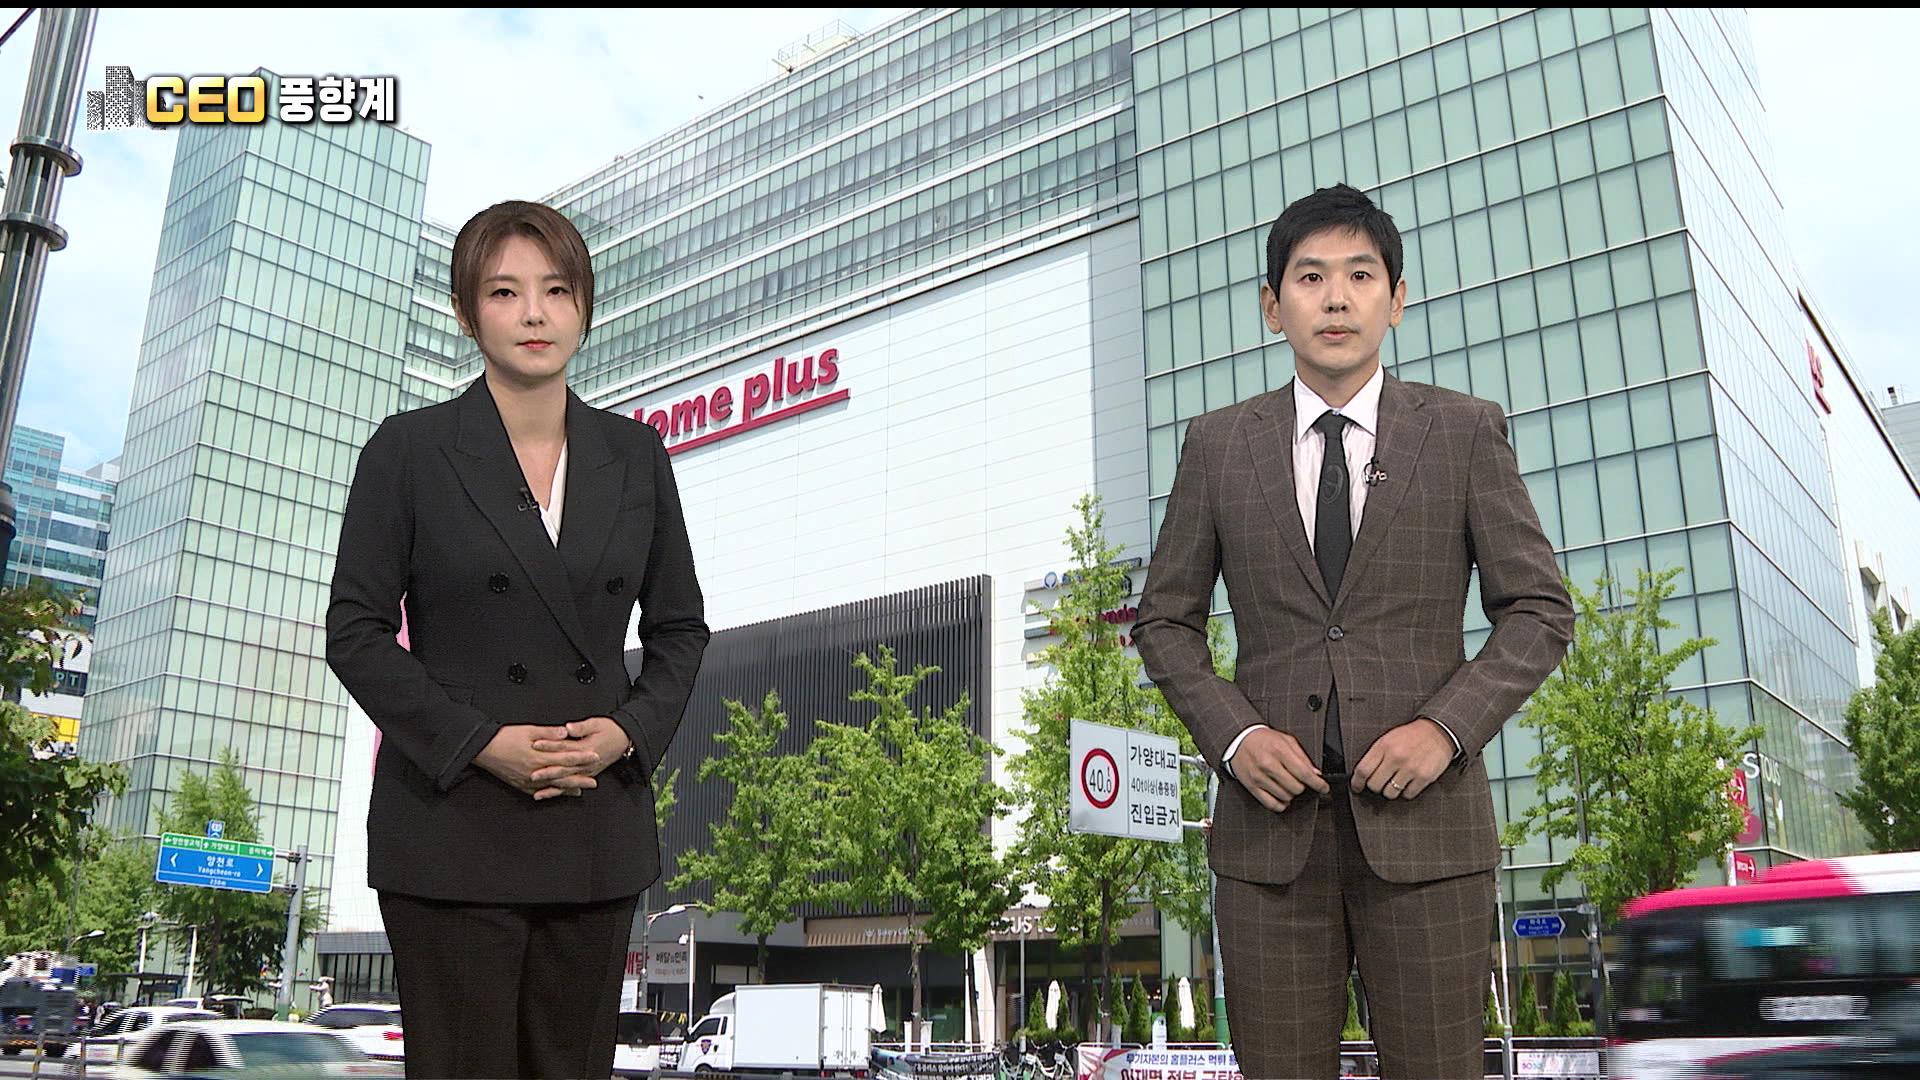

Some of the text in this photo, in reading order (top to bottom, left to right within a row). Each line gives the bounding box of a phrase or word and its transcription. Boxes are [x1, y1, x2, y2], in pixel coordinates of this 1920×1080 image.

[635, 348, 839, 439] ome plus
[1130, 745, 1178, 769] 가양대교
[1130, 803, 1180, 828] 진입금지
[206, 856, 234, 868] 양천로
[198, 865, 241, 878] Yangcheon-ro
[1171, 1054, 1205, 1066] 홈플러스
